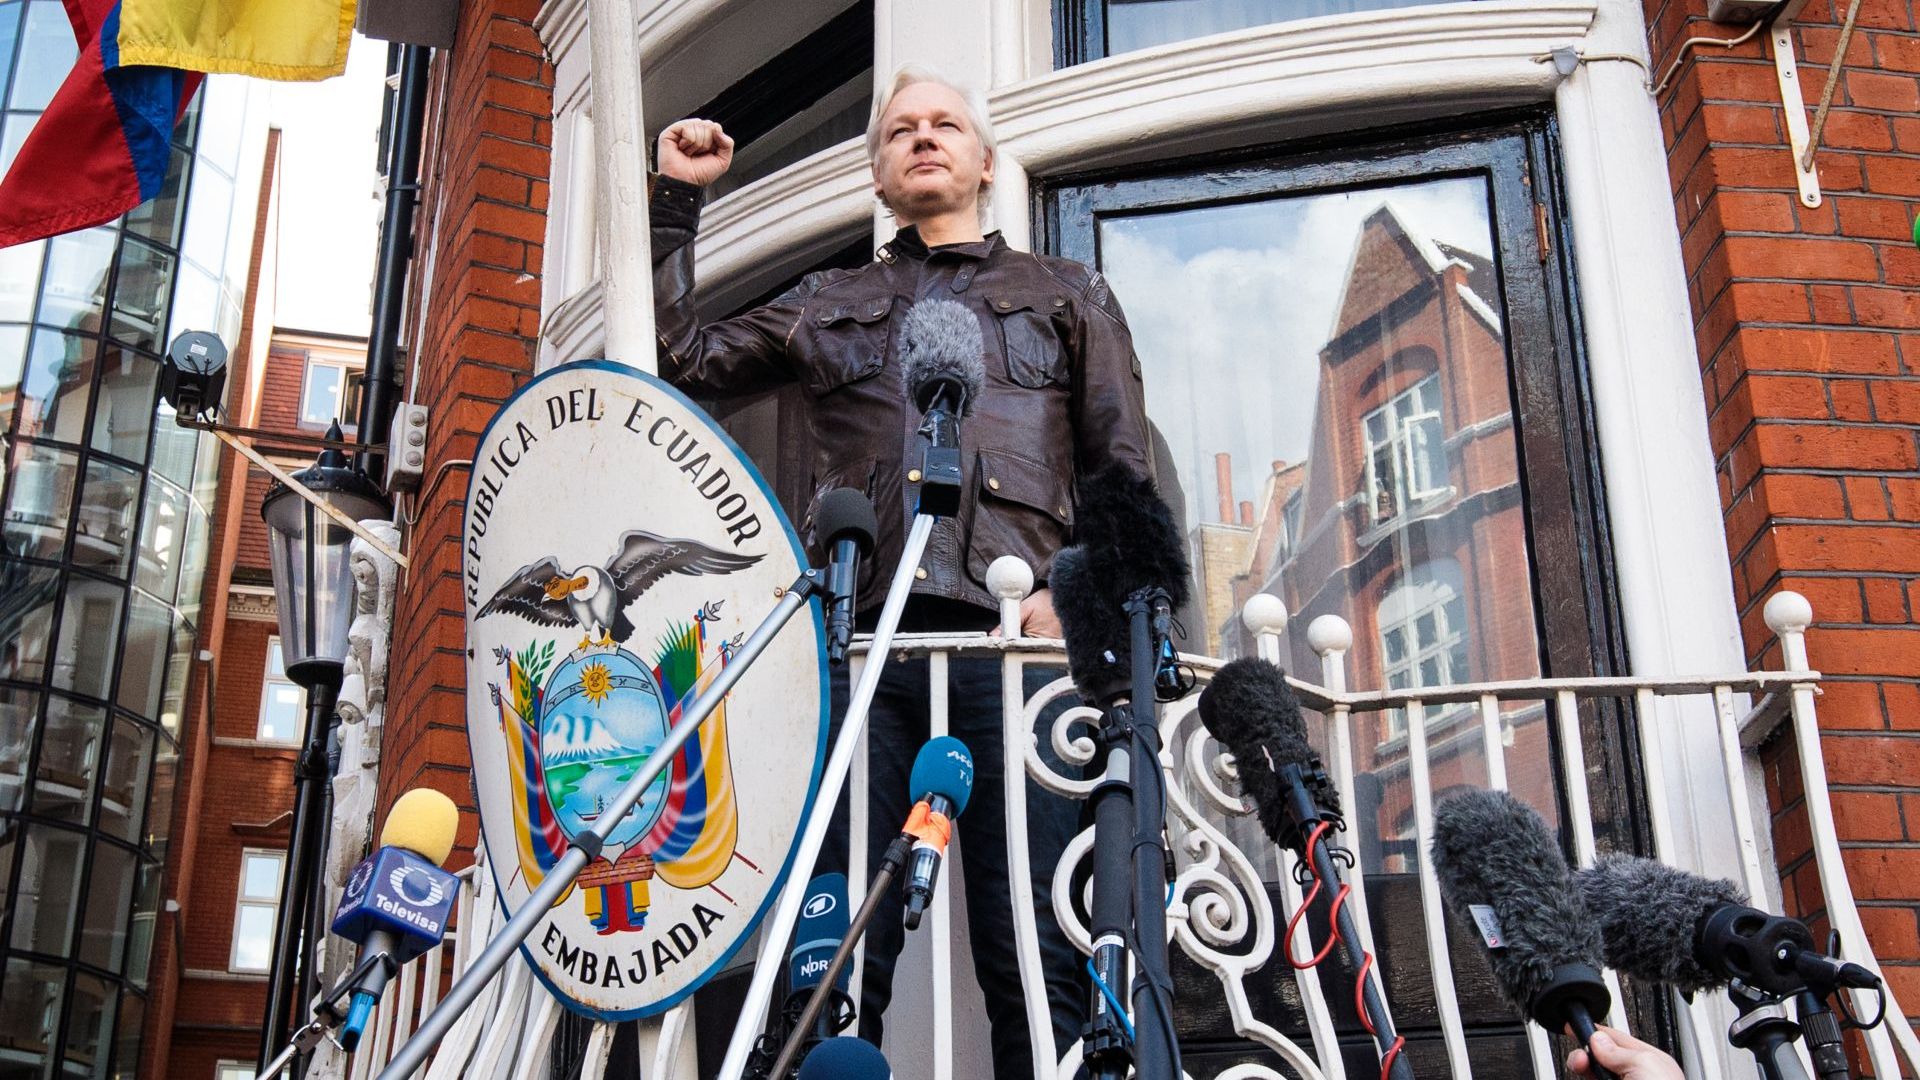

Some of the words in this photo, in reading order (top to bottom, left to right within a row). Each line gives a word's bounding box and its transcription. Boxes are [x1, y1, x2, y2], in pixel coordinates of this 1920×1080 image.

[467, 421, 538, 607] REPUBLICA
[545, 388, 602, 430] DEL
[623, 398, 762, 548] ECUADOR
[376, 893, 439, 933] Televisa
[541, 903, 726, 988] EMBAJADA
[800, 956, 829, 978] NDR
